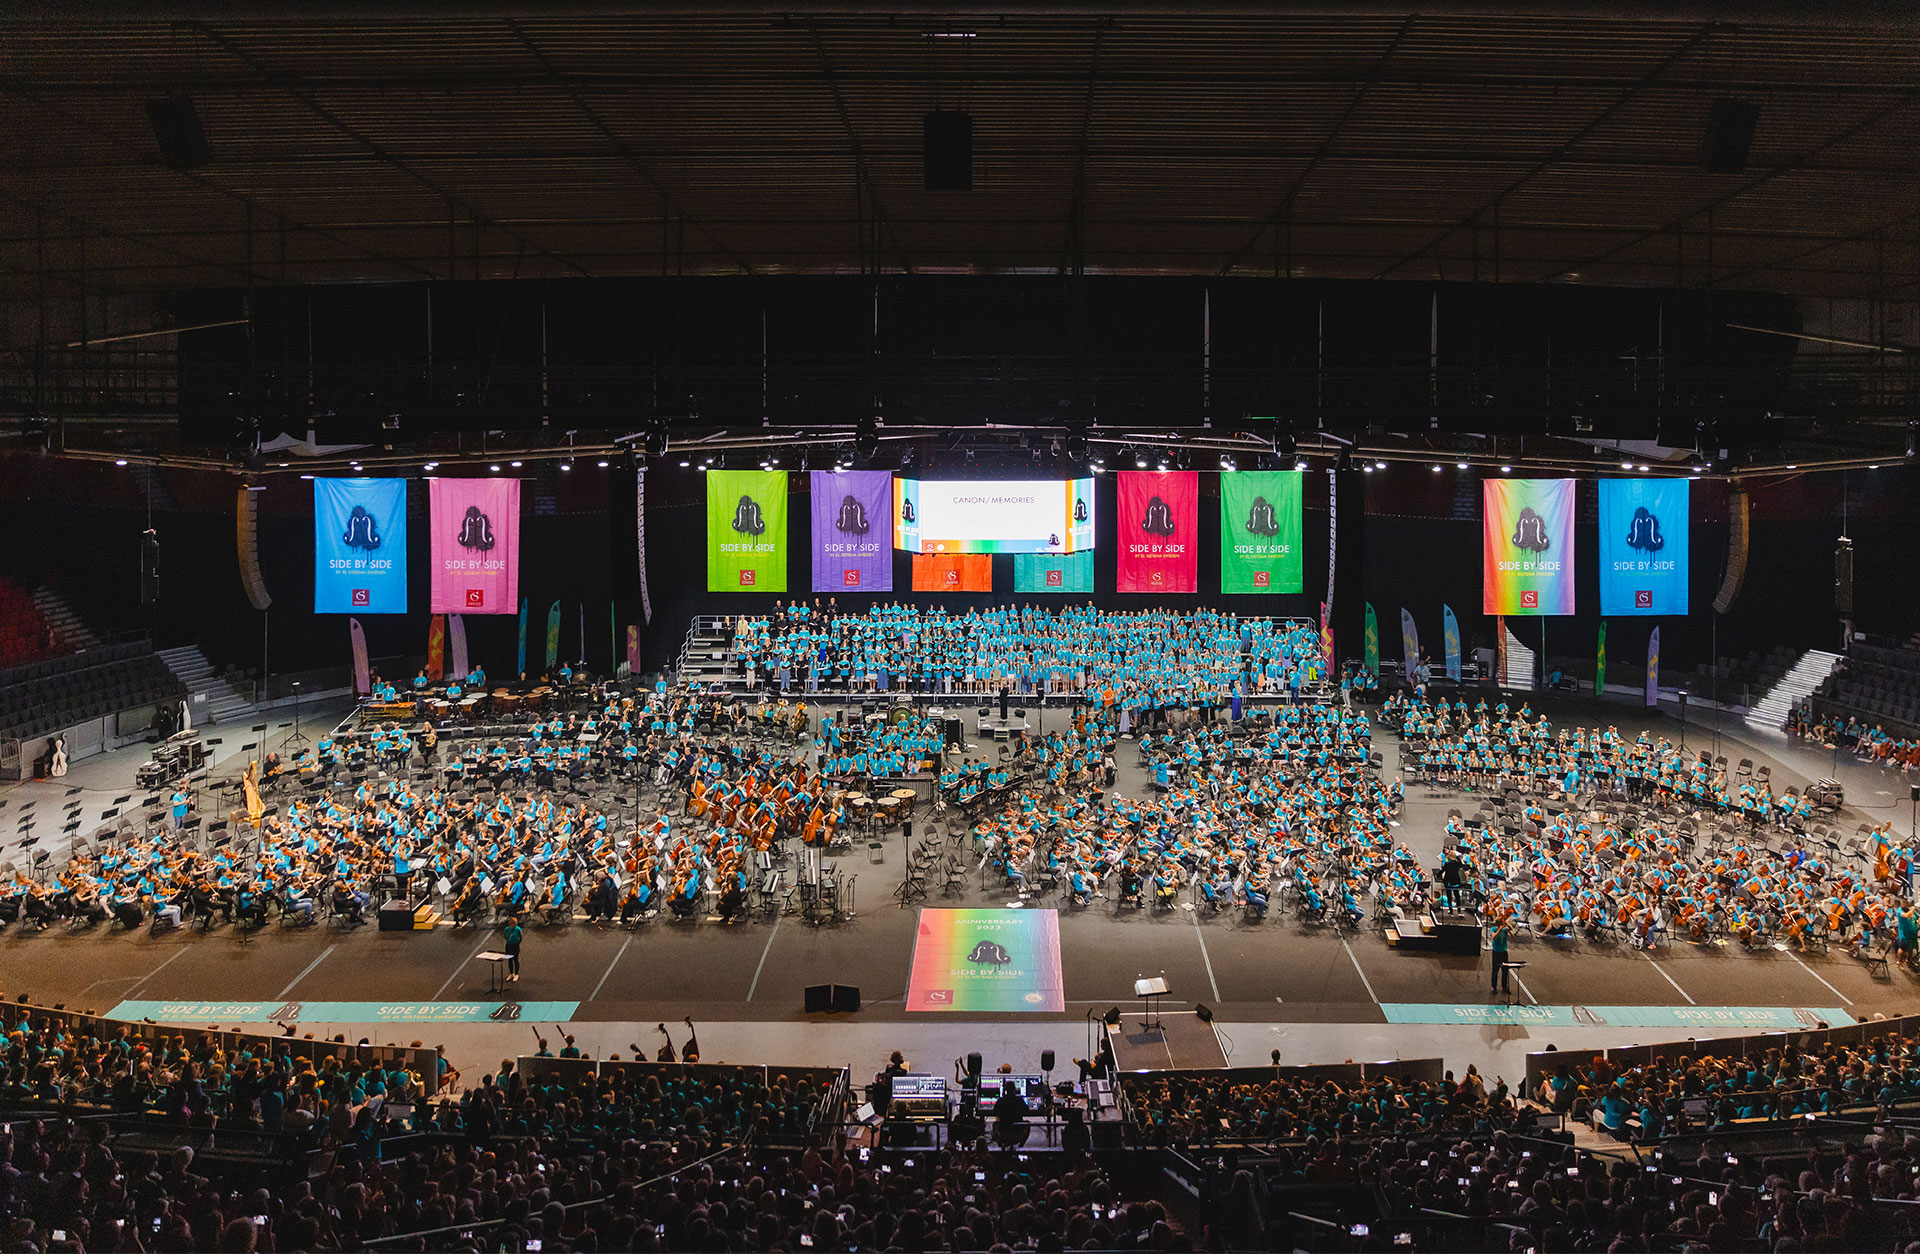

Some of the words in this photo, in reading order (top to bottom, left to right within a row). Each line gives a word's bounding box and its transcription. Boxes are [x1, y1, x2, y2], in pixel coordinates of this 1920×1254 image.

[720, 544, 739, 552] SIDE
[742, 544, 753, 552] BY
[756, 544, 775, 552] SIDE
[824, 544, 843, 552] SIDE
[847, 544, 857, 552] BY
[860, 544, 879, 552] SIDE
[1130, 544, 1149, 552] SIDE
[1152, 544, 1163, 552] BY
[1166, 544, 1185, 552] SIDE
[1234, 545, 1254, 553] SIDE
[1257, 545, 1267, 553] BY
[1270, 545, 1290, 553] SIDE
[329, 559, 351, 569] SIDE
[355, 559, 367, 569] BY
[370, 559, 392, 569] SIDE
[445, 560, 466, 569] SIDE
[469, 560, 481, 569] BY
[484, 560, 505, 569] SIDE
[1499, 561, 1520, 570] SIDE
[1524, 561, 1536, 570] BY
[1539, 561, 1560, 570] SIDE
[1614, 562, 1635, 570] SIDE
[1638, 561, 1650, 570] BY
[1654, 561, 1675, 570] SIDE
[158, 1006, 196, 1014] SIDE
[377, 1006, 415, 1014] SIDE
[418, 1006, 440, 1014] BY
[442, 1006, 480, 1014] SIDE
[1454, 1008, 1490, 1016] SIDE
[1520, 1010, 1556, 1018] SIDE
[1674, 1010, 1712, 1019] SIDE
[1715, 1011, 1735, 1019] BY
[1740, 1011, 1778, 1019] SIDE
